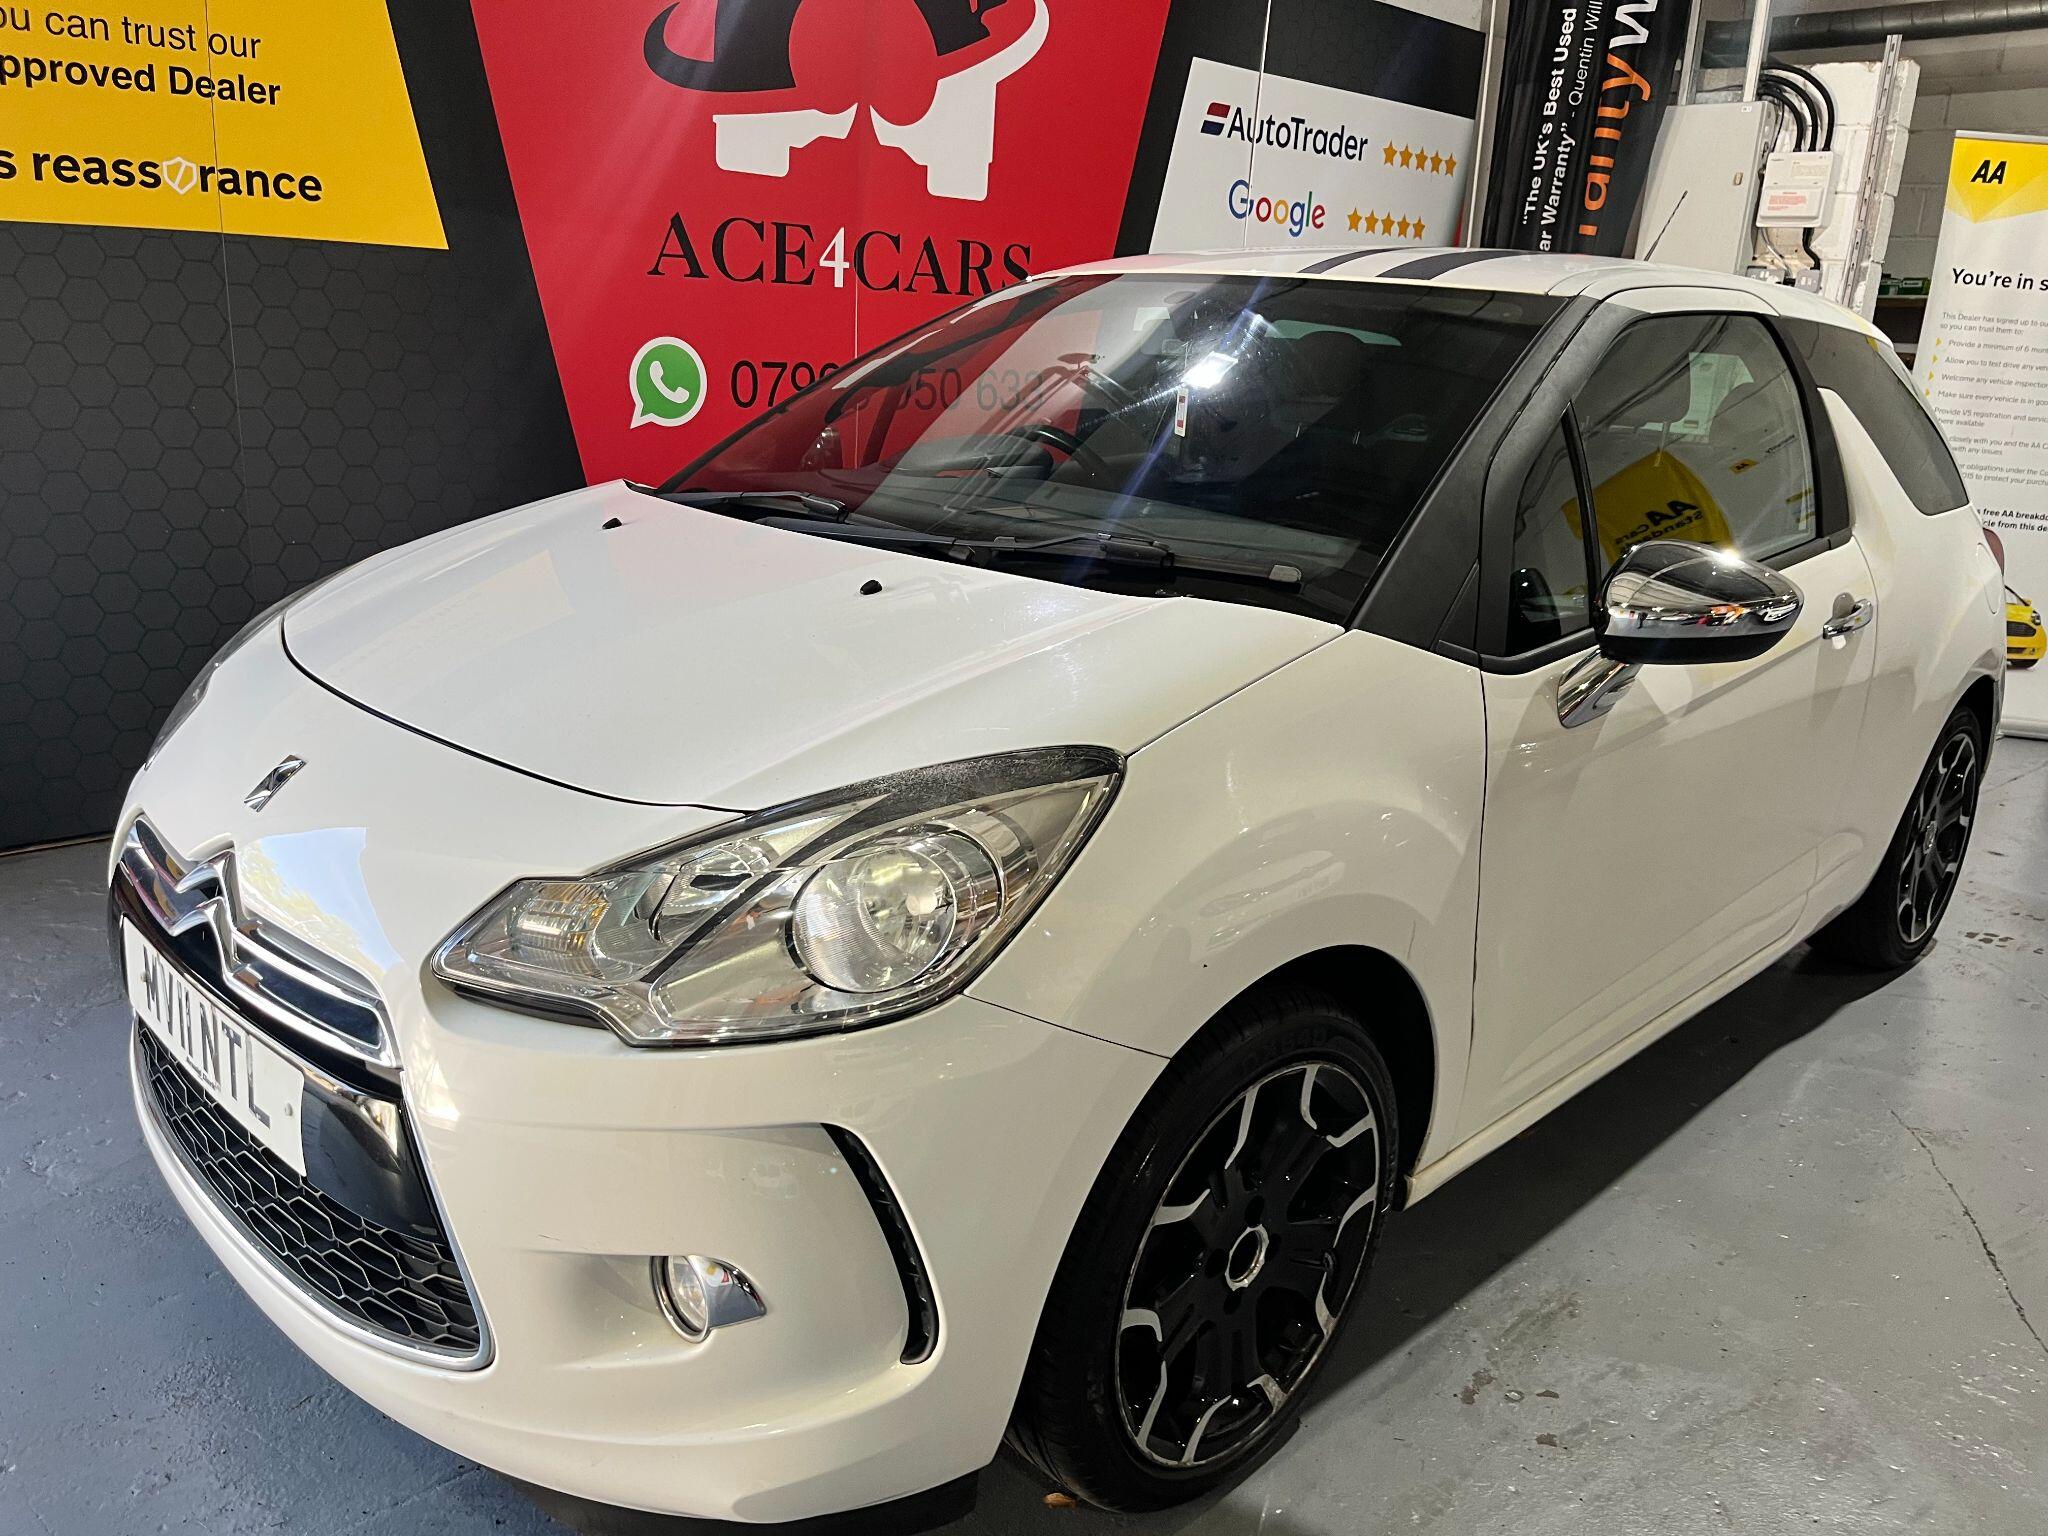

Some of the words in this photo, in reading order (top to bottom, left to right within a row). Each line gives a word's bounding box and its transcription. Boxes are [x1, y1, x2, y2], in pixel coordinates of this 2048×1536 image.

[46, 12, 109, 41] can
[122, 16, 197, 53] trust
[209, 27, 262, 60] our
[1553, 8, 1577, 62] Used
[1569, 38, 1594, 106] Quentin
[168, 66, 282, 106] Dealer
[1544, 69, 1565, 116] Best
[1226, 107, 1368, 162] AutoTrader
[33, 153, 322, 203] reassrance
[1970, 160, 2007, 184] AA
[1228, 179, 1326, 236] Google
[647, 212, 1031, 296] ACE4CARS
[2017, 273, 2034, 290] in
[1949, 339, 1975, 347] Provide
[1945, 356, 1965, 364] Allow
[2003, 361, 2019, 369] drive
[1942, 374, 1974, 382] Welcome
[1989, 377, 2013, 385] vehicle
[1994, 395, 2018, 403] vehicle
[1935, 407, 1961, 415] Provide
[1974, 410, 2011, 419] registration
[1966, 464, 2004, 473] obligations
[2006, 466, 2025, 474] under
[1983, 508, 2000, 516] free
[1998, 520, 2017, 530] from
[2020, 522, 2034, 530] this
